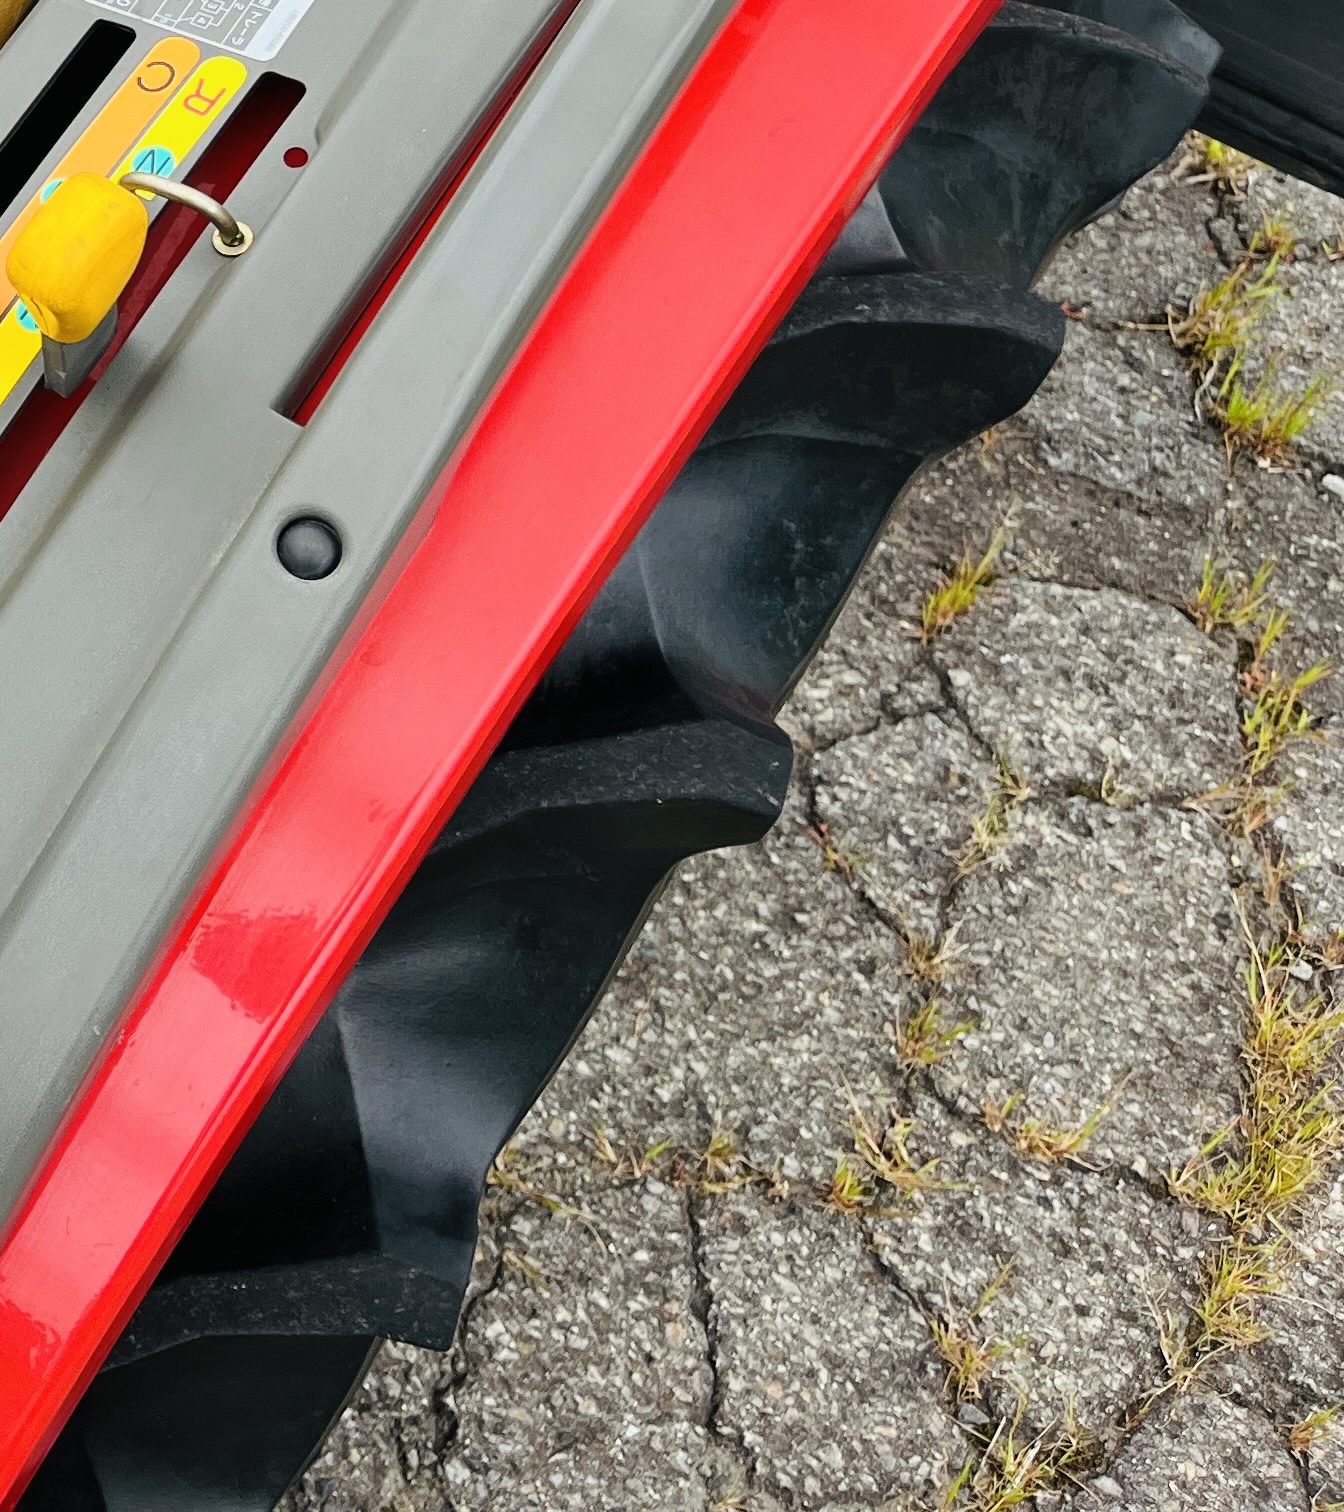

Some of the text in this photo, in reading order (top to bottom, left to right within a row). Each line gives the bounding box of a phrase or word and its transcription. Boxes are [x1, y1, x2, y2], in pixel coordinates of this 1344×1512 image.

[232, 2, 245, 11] 2
[227, 10, 264, 46] トレーラ
[137, 61, 175, 92] C
[182, 78, 224, 117] R
[134, 149, 171, 178] N
